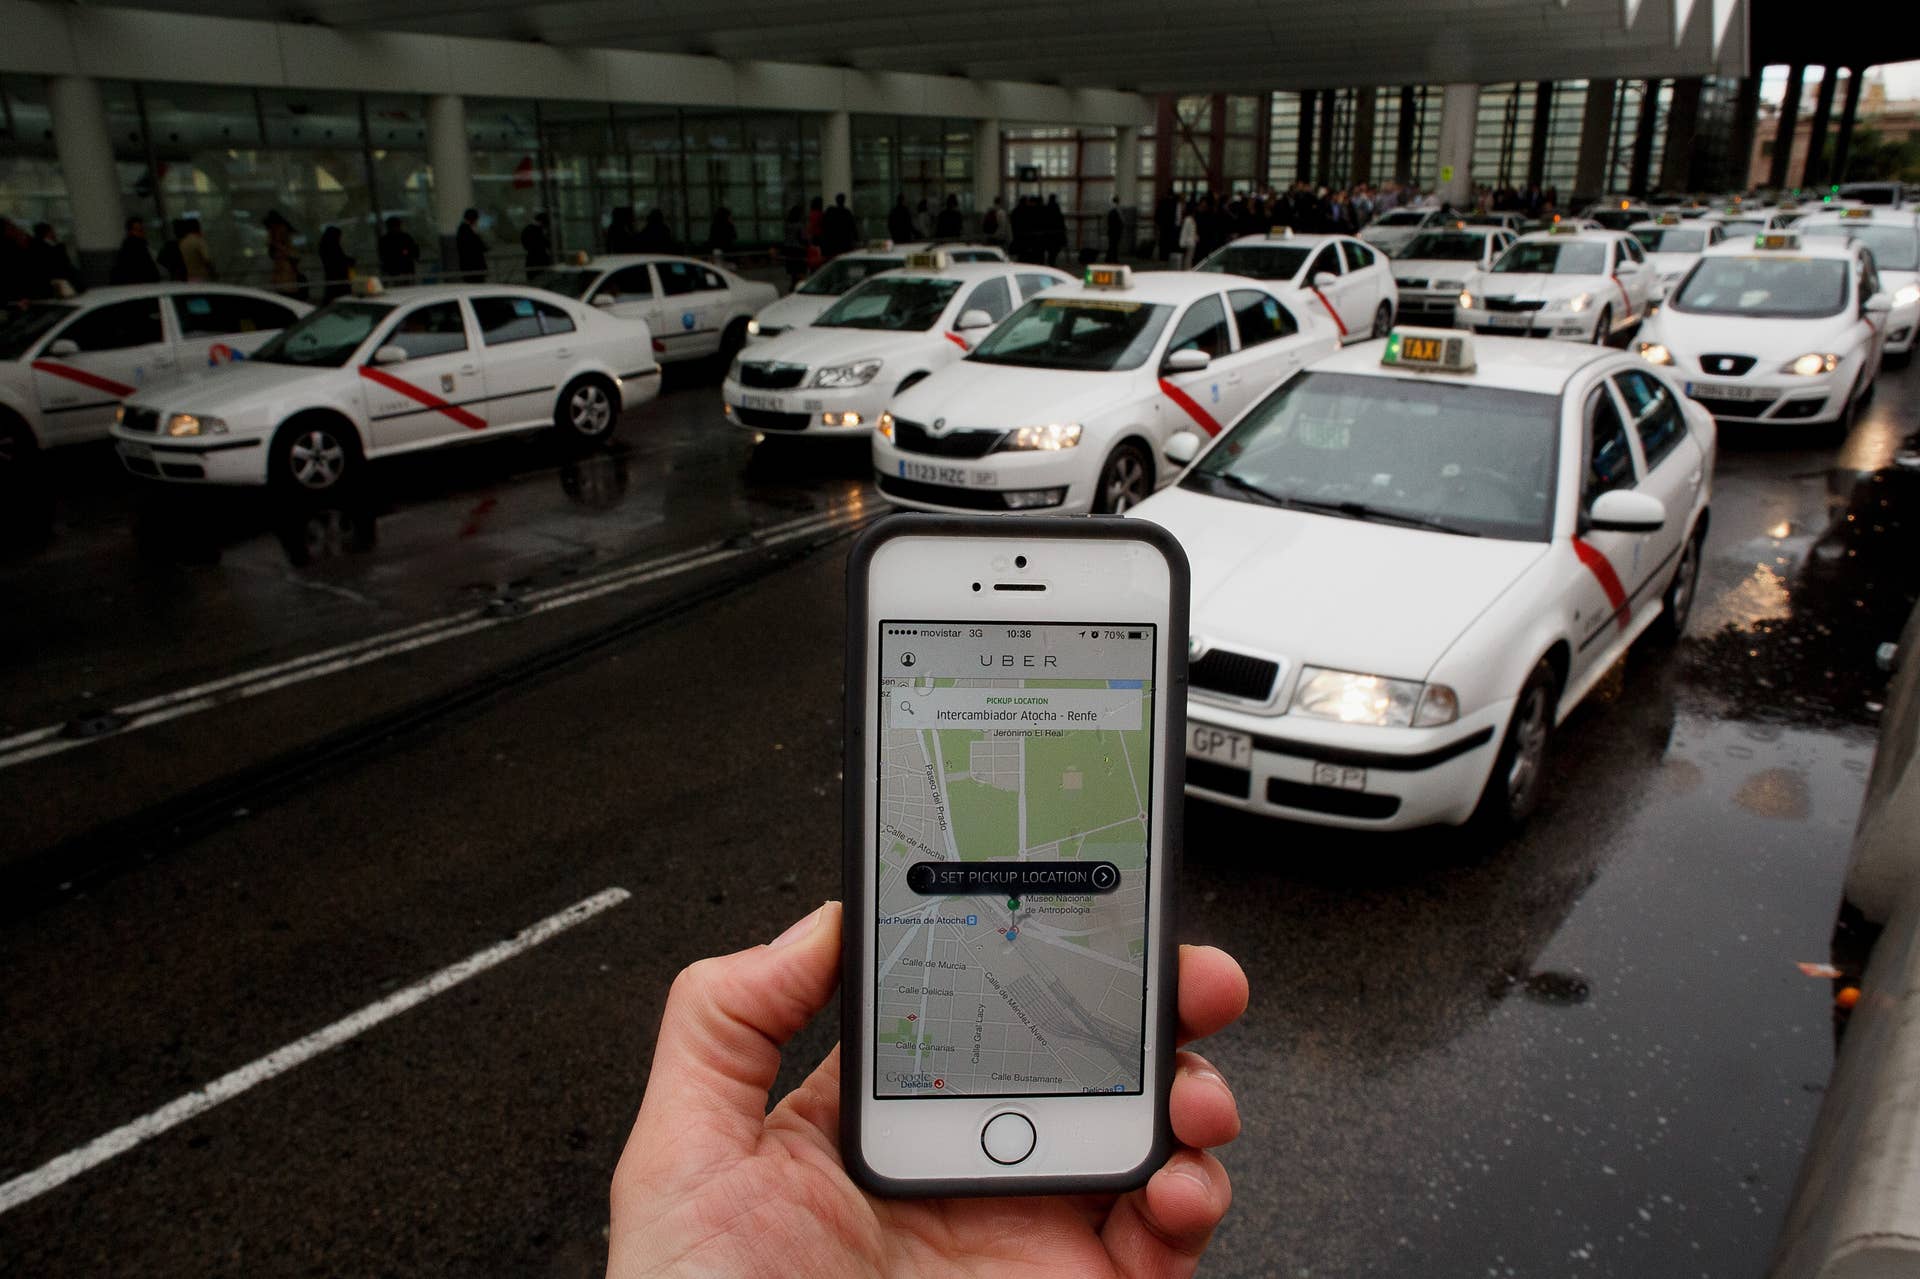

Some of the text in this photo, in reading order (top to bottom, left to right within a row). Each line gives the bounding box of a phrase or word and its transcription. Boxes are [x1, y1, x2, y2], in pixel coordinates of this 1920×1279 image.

[1404, 337, 1441, 360] TAXI
[908, 461, 965, 484] 1123 HZC
[920, 629, 983, 638] movistar 3G
[1007, 630, 1032, 639] 10:36
[1104, 630, 1125, 640] 70%
[980, 655, 1057, 667] UBER
[986, 697, 1049, 705] PICKUP LOCATION
[937, 710, 1017, 721] Intercambiador
[1021, 710, 1057, 722] Atocha
[1068, 711, 1097, 722] Renfe
[993, 729, 1032, 738] Jerónimo
[1194, 727, 1242, 760] GPT
[1319, 766, 1360, 789] SP
[925, 764, 947, 831] Paseo del Prado
[886, 825, 906, 840] Calle
[917, 842, 945, 861] Atocha
[940, 872, 1087, 884] SET PICKUP LOCATION
[1025, 895, 1092, 903] Museo Nacional
[894, 916, 921, 925] Puerta
[923, 917, 935, 925] de
[937, 916, 966, 925] Atocha
[902, 958, 967, 971] Calle de Murcia
[984, 971, 1001, 989] Calle
[898, 985, 954, 997] Calle Delicias
[975, 1003, 986, 1022] Lacy
[895, 1041, 955, 1053] Calle Canarias
[971, 1043, 980, 1064] Calle
[886, 1070, 931, 1084] Google
[991, 1072, 1063, 1084] Calle Bustamante
[900, 1080, 933, 1088] Delicias
